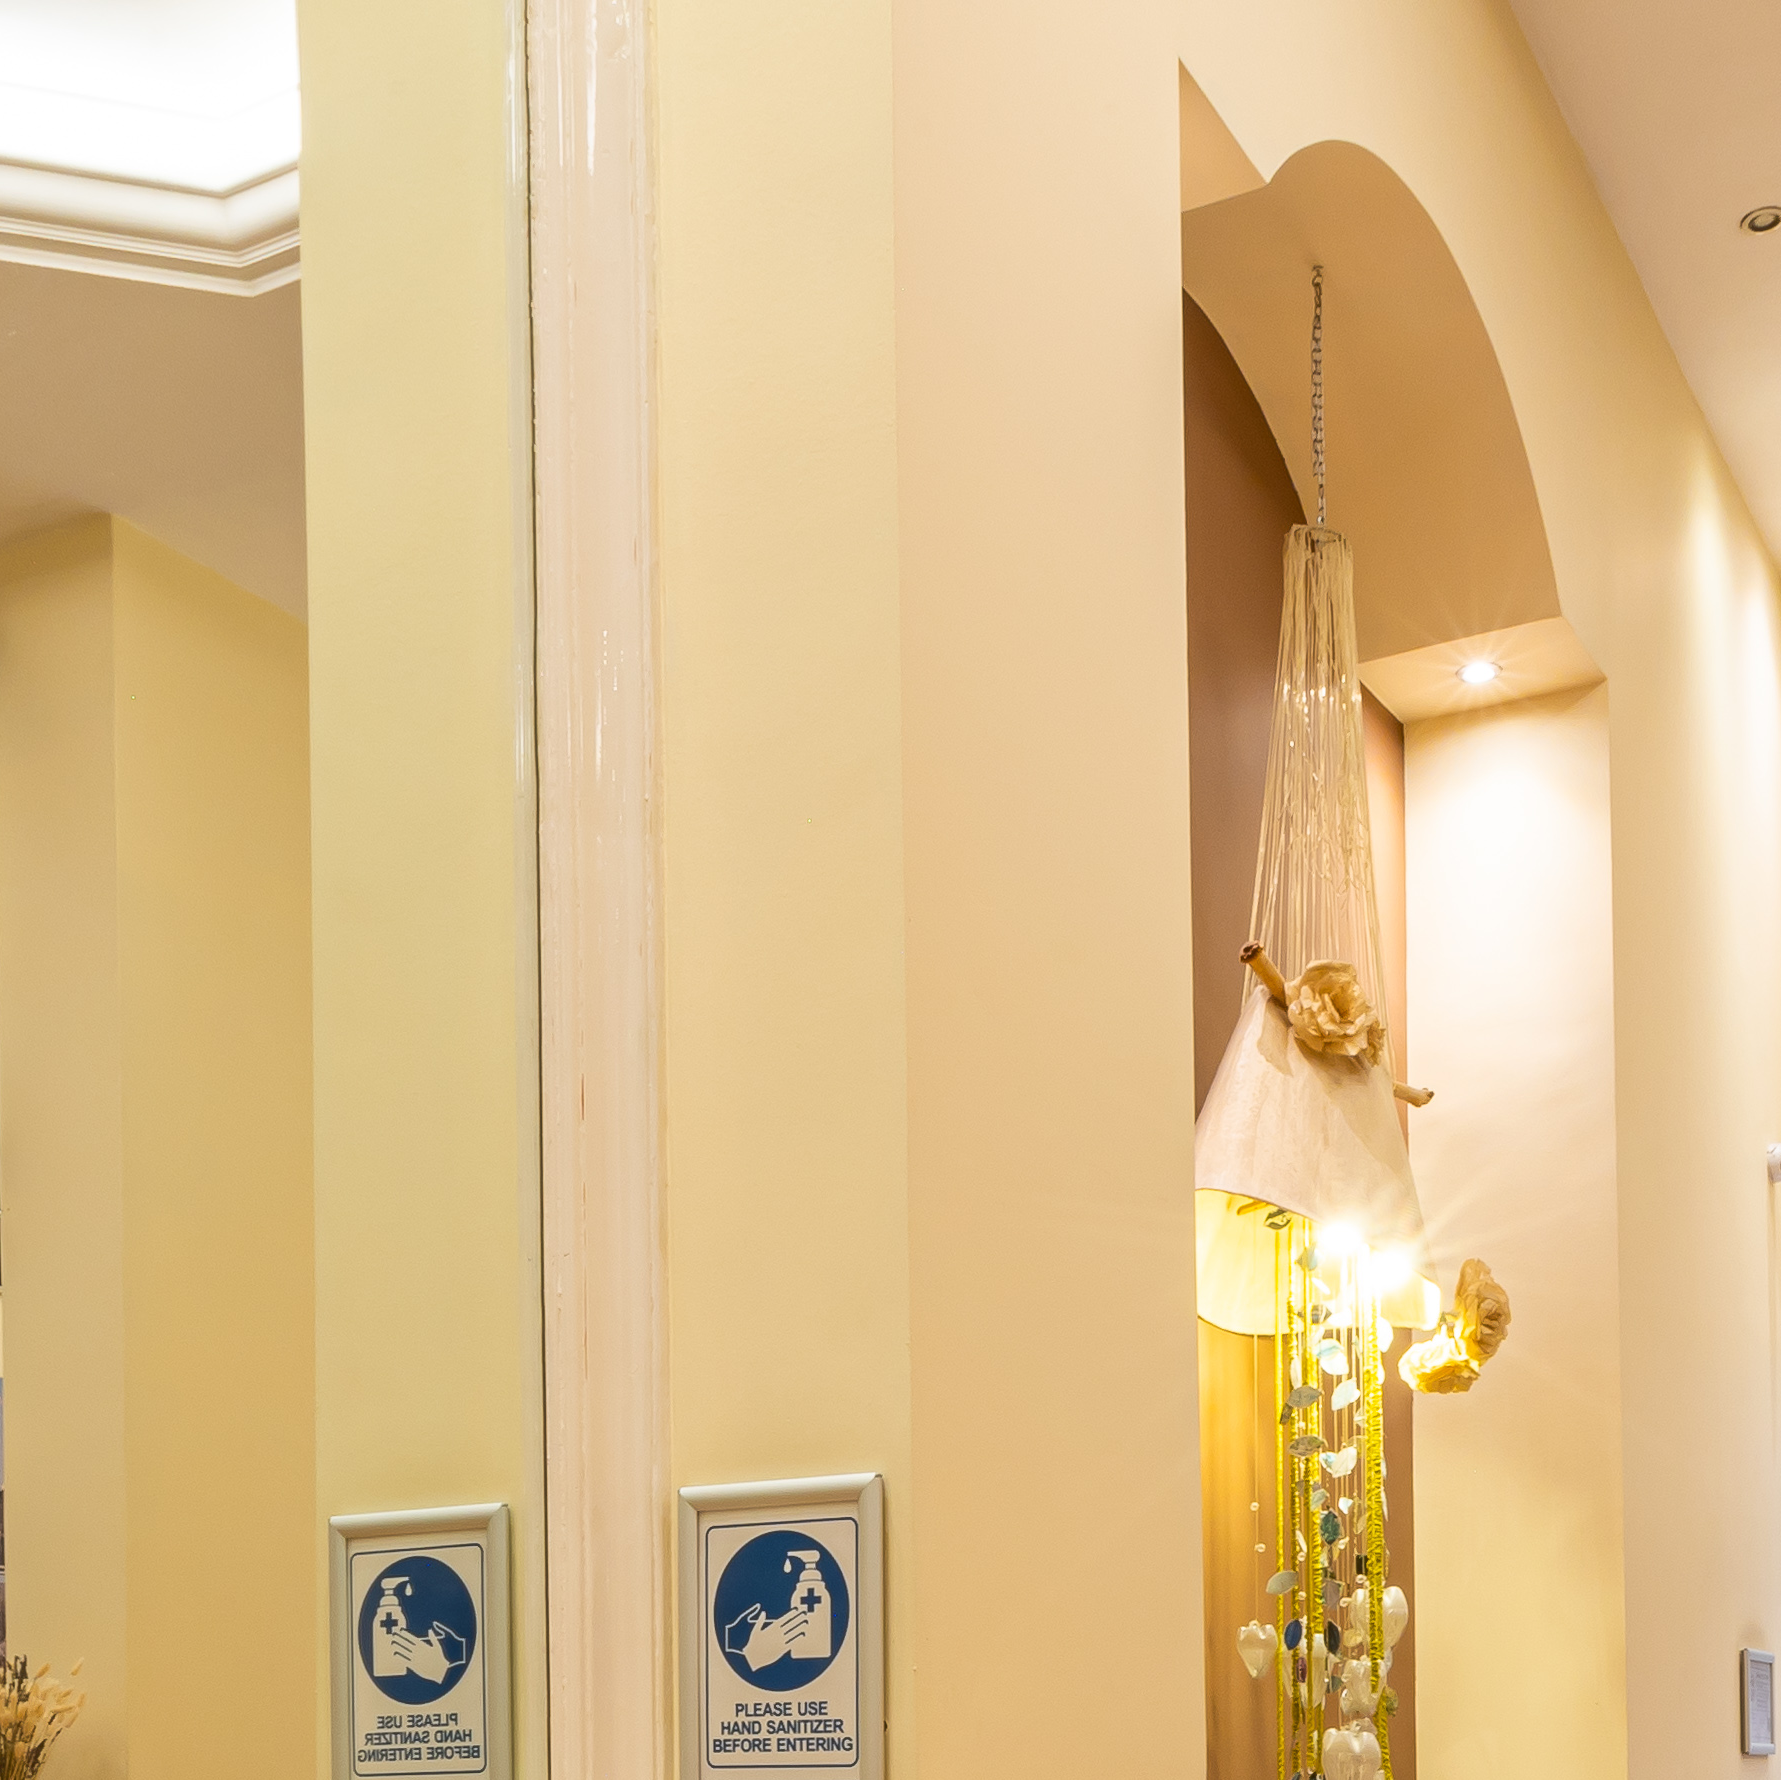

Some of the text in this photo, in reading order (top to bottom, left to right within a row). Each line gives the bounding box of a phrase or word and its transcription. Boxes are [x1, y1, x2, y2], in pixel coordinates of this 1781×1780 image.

[734, 1700, 829, 1718] PLEASE USE
[720, 1718, 845, 1736] HAND SANITIZER
[712, 1736, 854, 1754] BEFORE ENTERING
